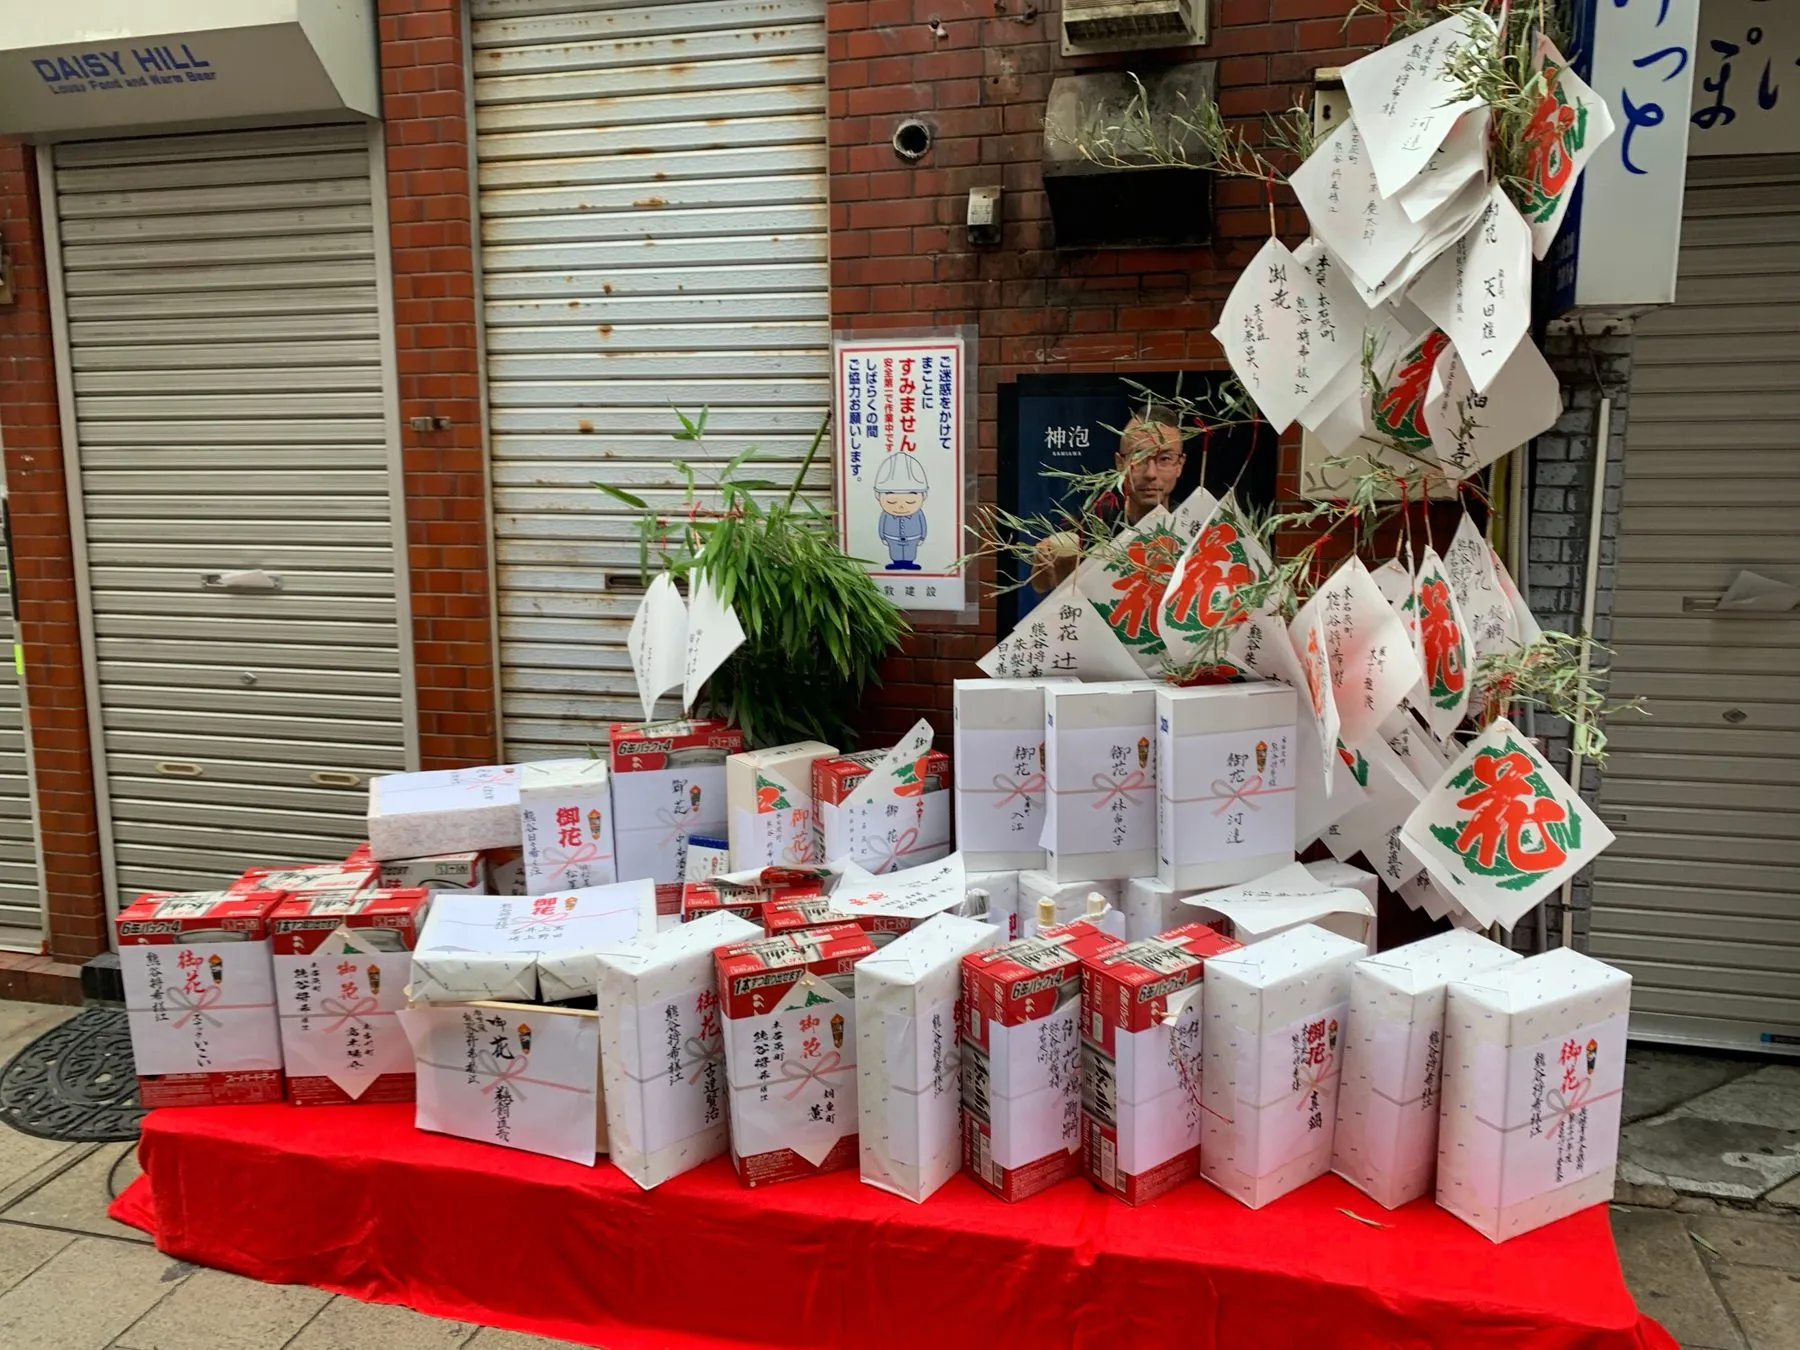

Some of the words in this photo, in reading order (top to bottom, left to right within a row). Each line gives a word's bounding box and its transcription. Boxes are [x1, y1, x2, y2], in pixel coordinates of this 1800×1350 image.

[31, 51, 125, 83] DAISY
[131, 44, 210, 73] HILL
[125, 76, 148, 88] and
[866, 358, 879, 439] しばらくの間
[898, 358, 917, 452] すみません
[922, 356, 934, 410] まことに
[938, 356, 952, 450] ご迷惑をかけて
[848, 358, 862, 482] ご協力お願いします。
[1044, 425, 1090, 449] 神泡
[1057, 604, 1083, 642] 御花
[1052, 651, 1078, 671] 辻
[1015, 745, 1036, 777] 御花
[1110, 744, 1132, 777] 御花
[1226, 752, 1250, 784] 御花
[555, 806, 584, 848] 御花
[1456, 752, 1568, 873] 花
[176, 949, 206, 994] 御花
[336, 960, 358, 1001] 御花
[486, 1014, 515, 1061] 御花
[696, 989, 722, 1042] 御花
[799, 1014, 823, 1060] 御花
[1305, 1018, 1326, 1068] 御花
[1558, 1038, 1583, 1094] 御花
